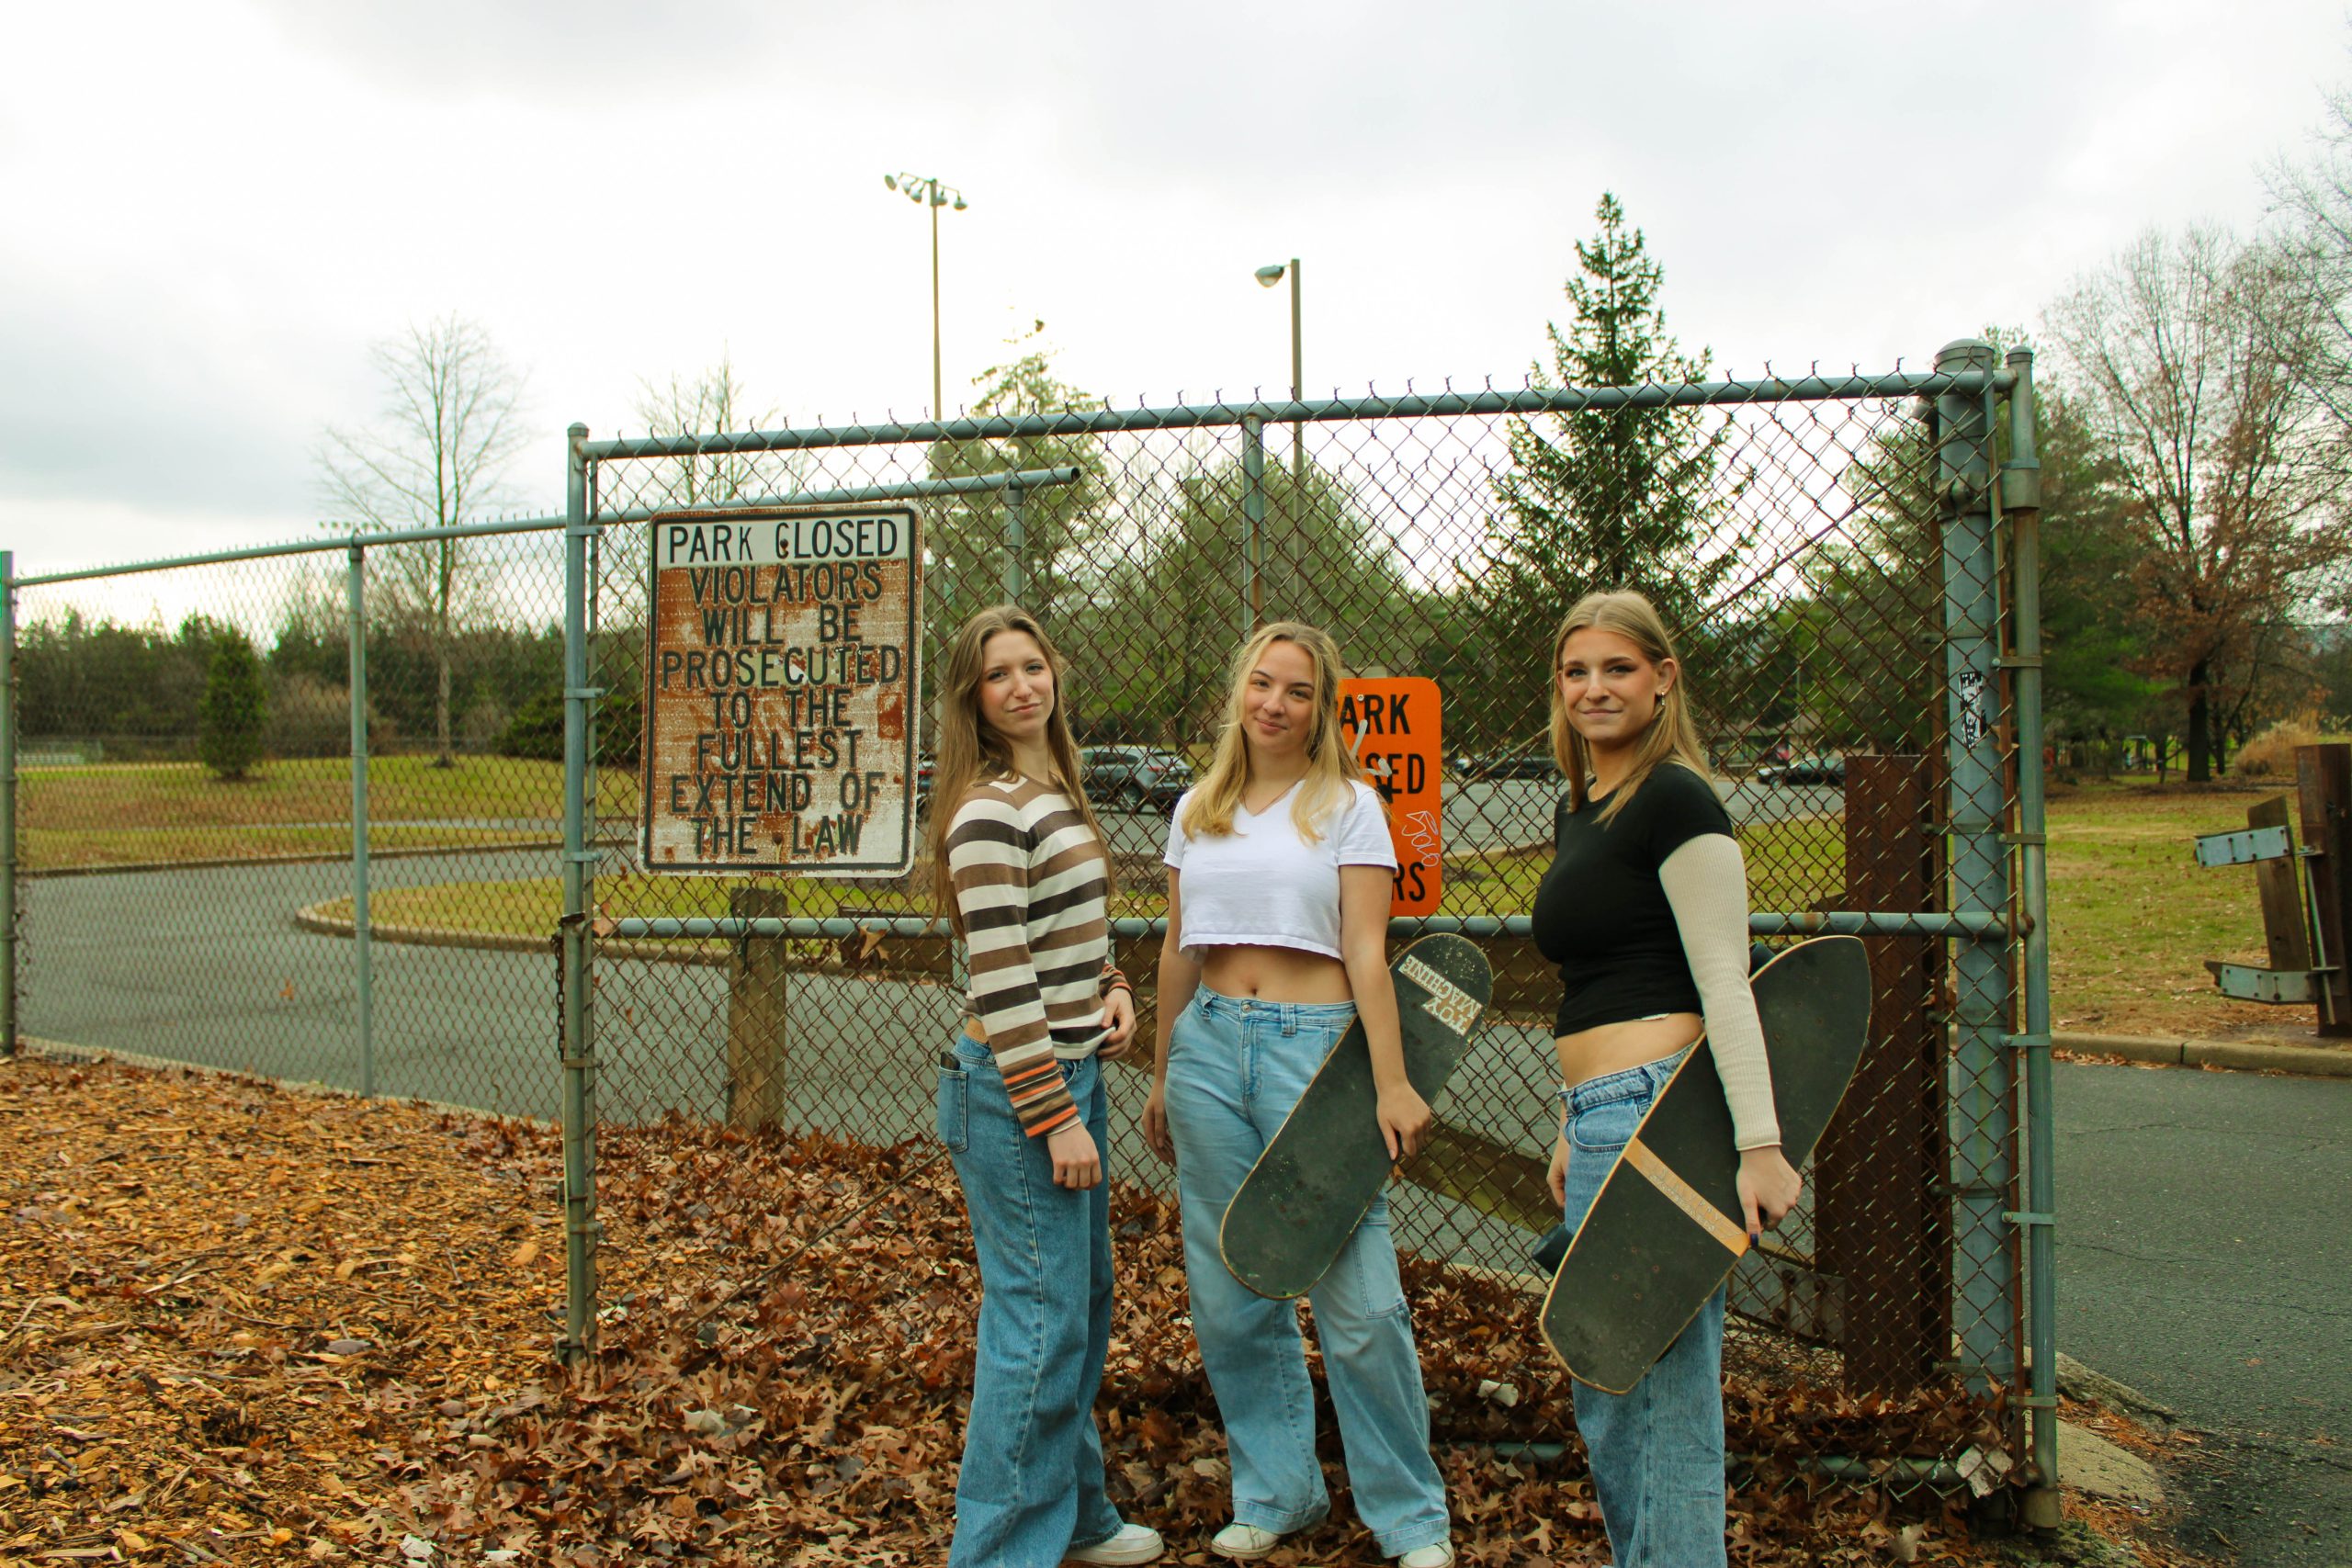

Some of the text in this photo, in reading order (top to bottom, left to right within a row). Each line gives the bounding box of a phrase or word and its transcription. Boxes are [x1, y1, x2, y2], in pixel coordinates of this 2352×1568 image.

[669, 519, 897, 563] PARK CLOSED
[689, 561, 882, 605] VIOLATORS
[702, 603, 862, 647] WILL BE
[662, 645, 900, 689] PROSECUTED
[710, 688, 852, 729] TO THE
[1340, 694, 1410, 734] ARK
[697, 729, 861, 771] FULLEST
[671, 772, 885, 812] EXTEND OF
[691, 814, 864, 854] THE LAW
[1398, 954, 1483, 1020] MACHINE
[1421, 996, 1468, 1036] TOY
